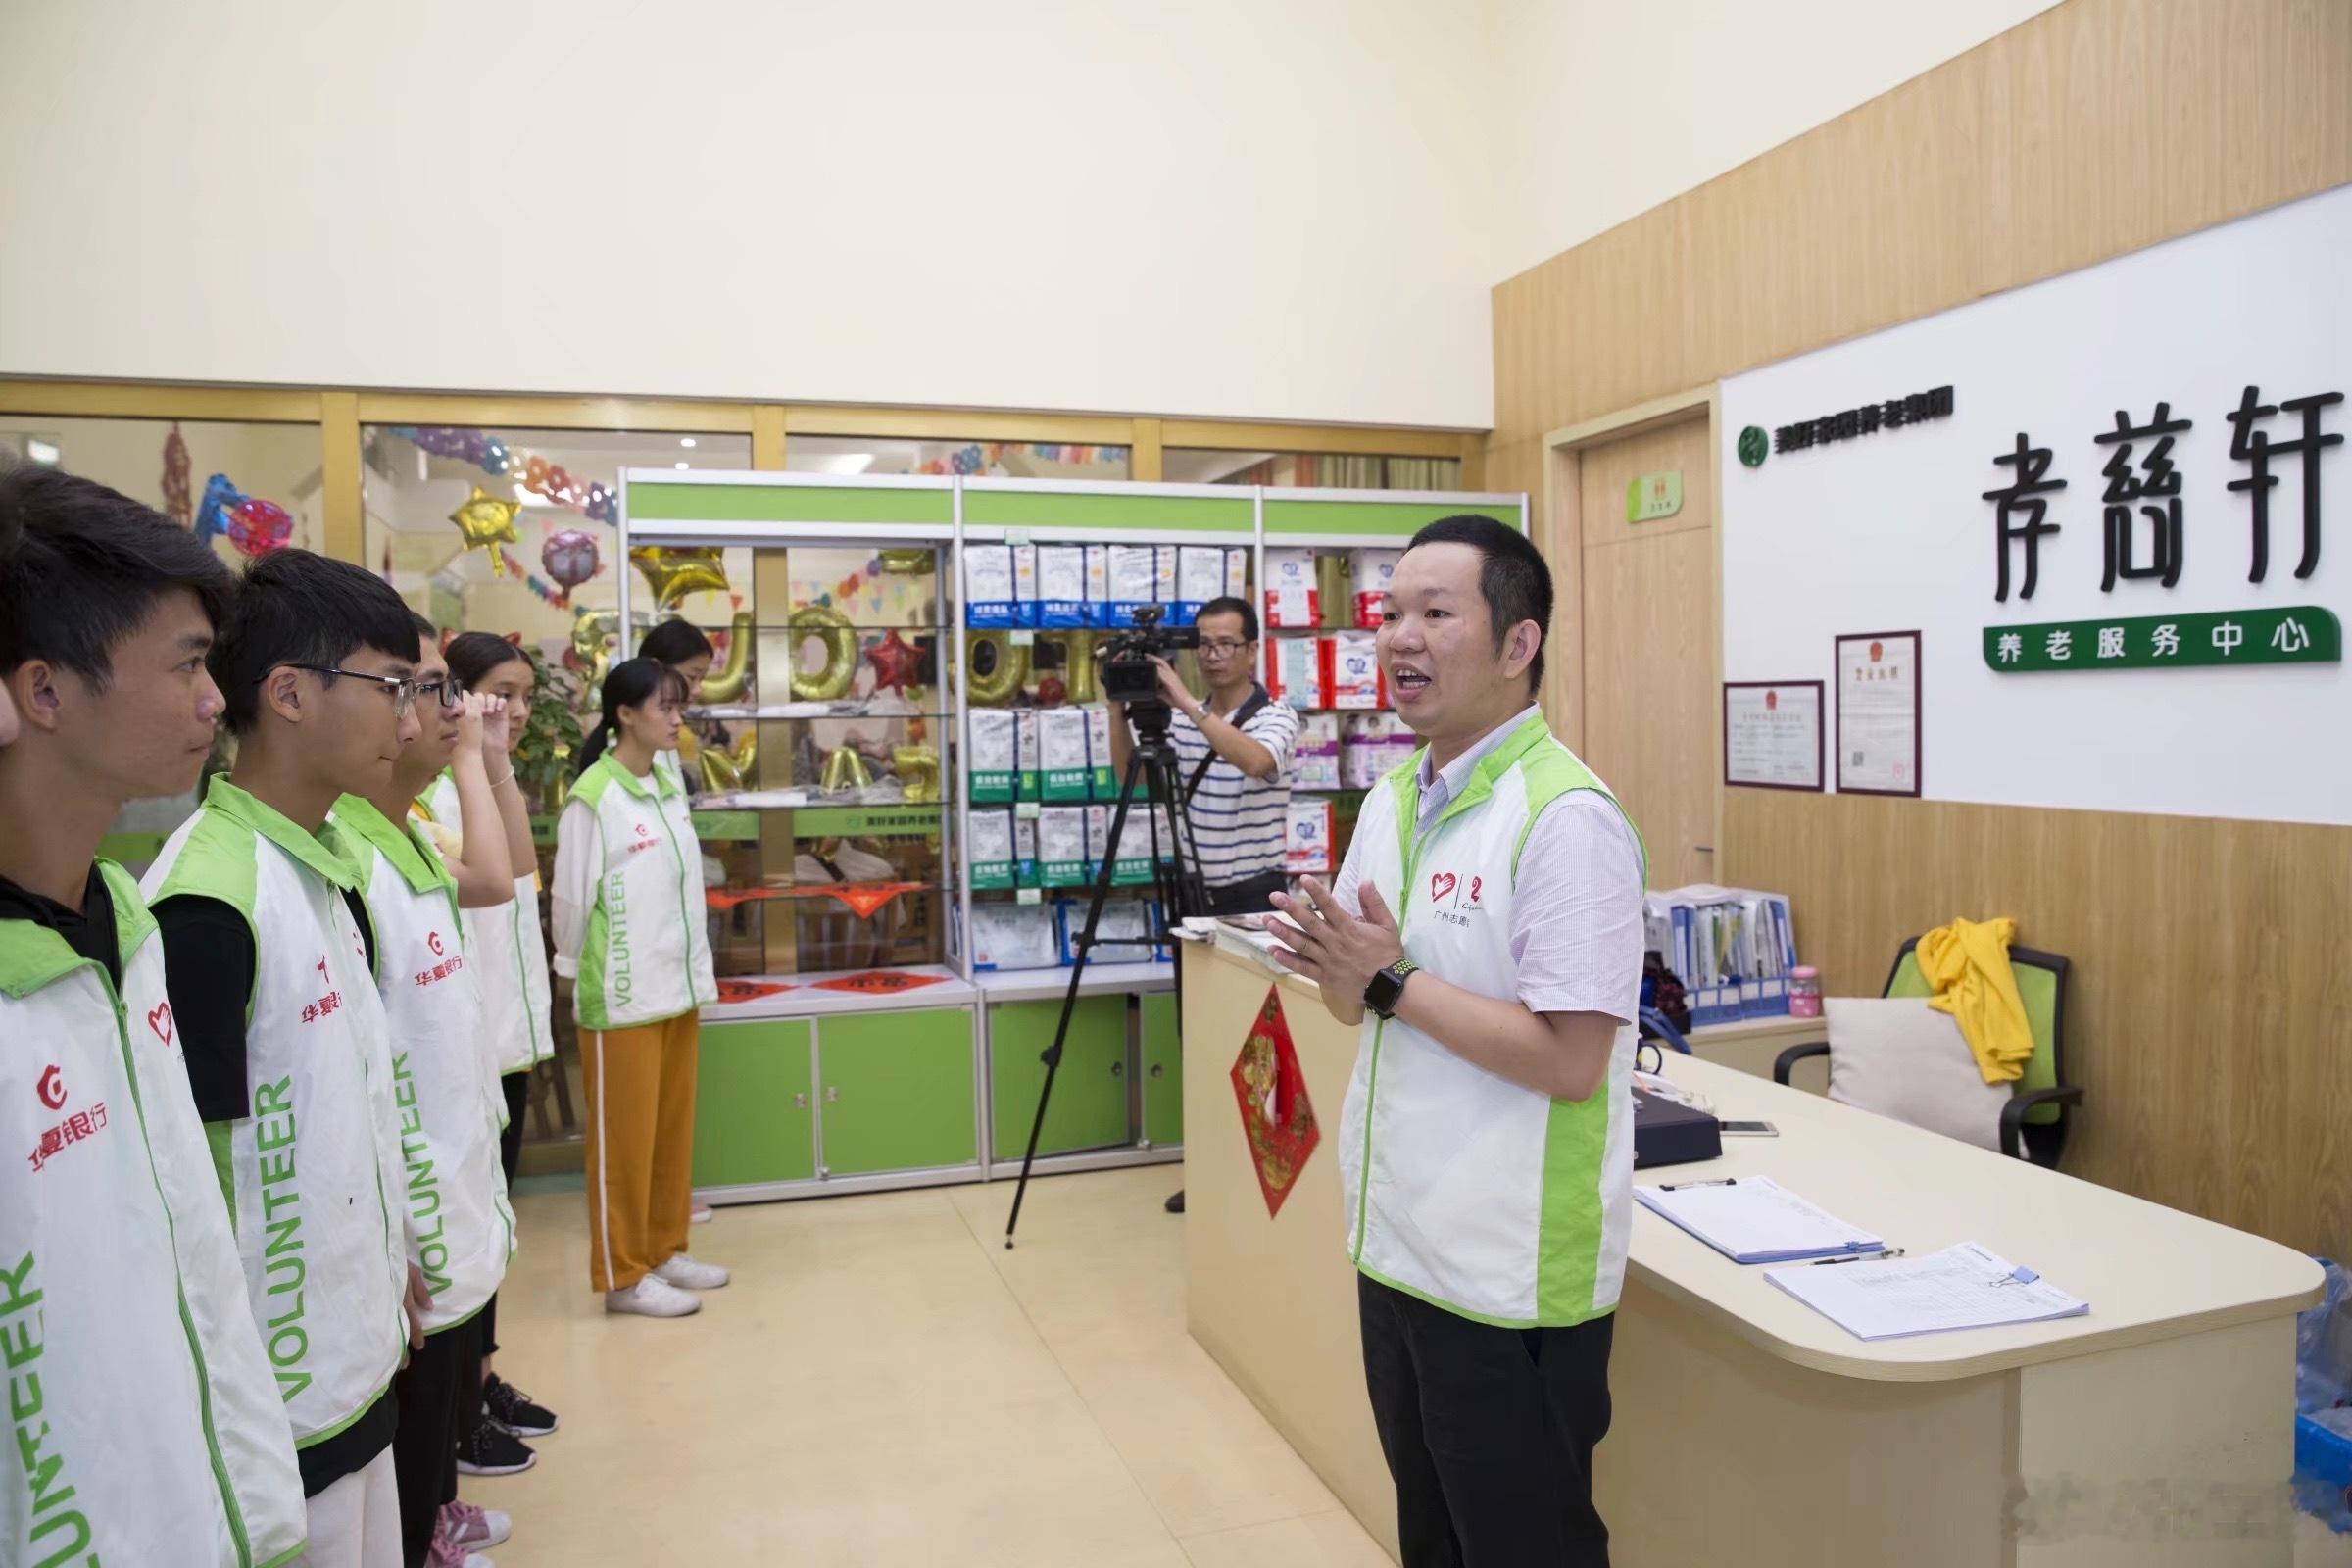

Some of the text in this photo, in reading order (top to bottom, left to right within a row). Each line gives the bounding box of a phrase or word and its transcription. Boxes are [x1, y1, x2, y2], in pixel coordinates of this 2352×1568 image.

[1997, 616, 2311, 664] 养老服务中心
[610, 870, 633, 1009] VOLUNTEER
[1433, 909, 1471, 928] 广州志愿
[255, 1074, 313, 1403] VOLUNTEER
[392, 1051, 453, 1298] VOLUNTEER
